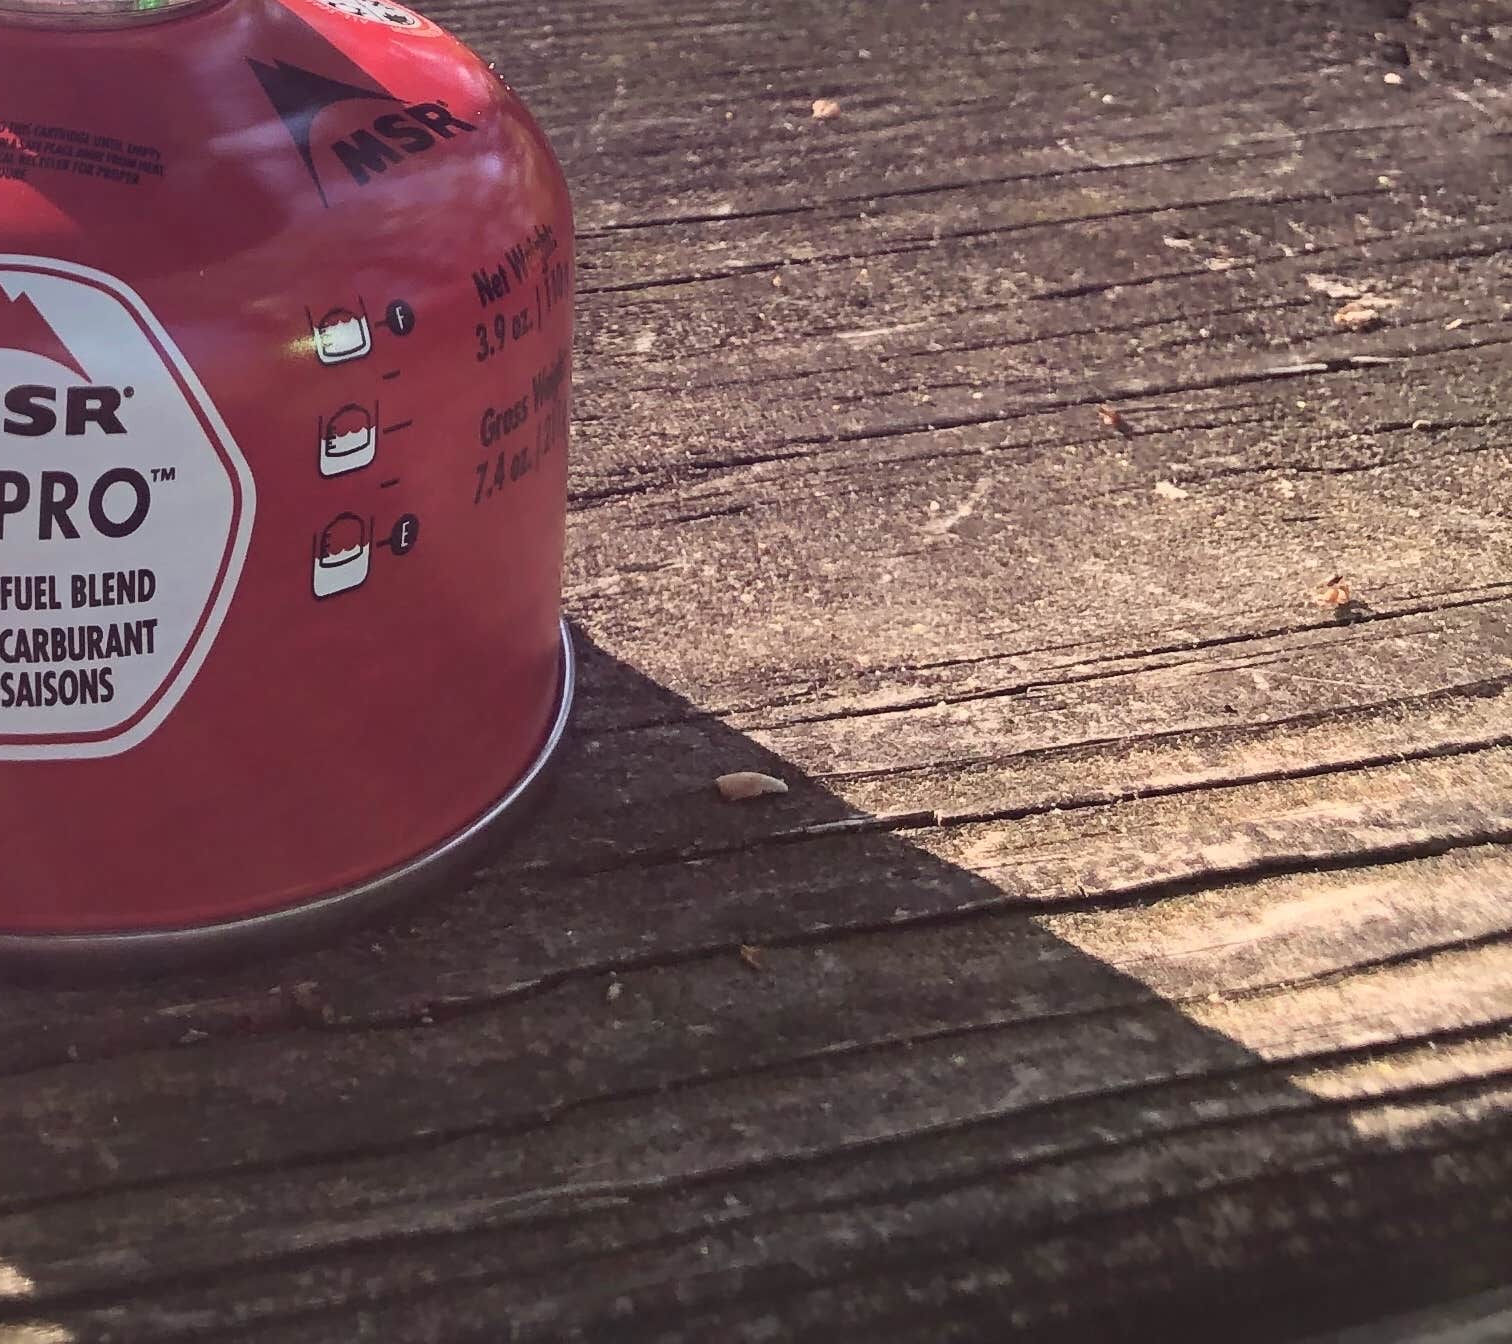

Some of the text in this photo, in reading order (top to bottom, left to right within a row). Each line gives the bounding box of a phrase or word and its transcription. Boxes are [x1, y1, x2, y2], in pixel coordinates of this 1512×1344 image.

[331, 102, 478, 187] MSR
[472, 264, 511, 309] Net
[475, 313, 506, 362] 3.9
[0, 575, 62, 611] FUEL
[71, 569, 157, 608] BLEND
[0, 667, 114, 708] SAISONS
